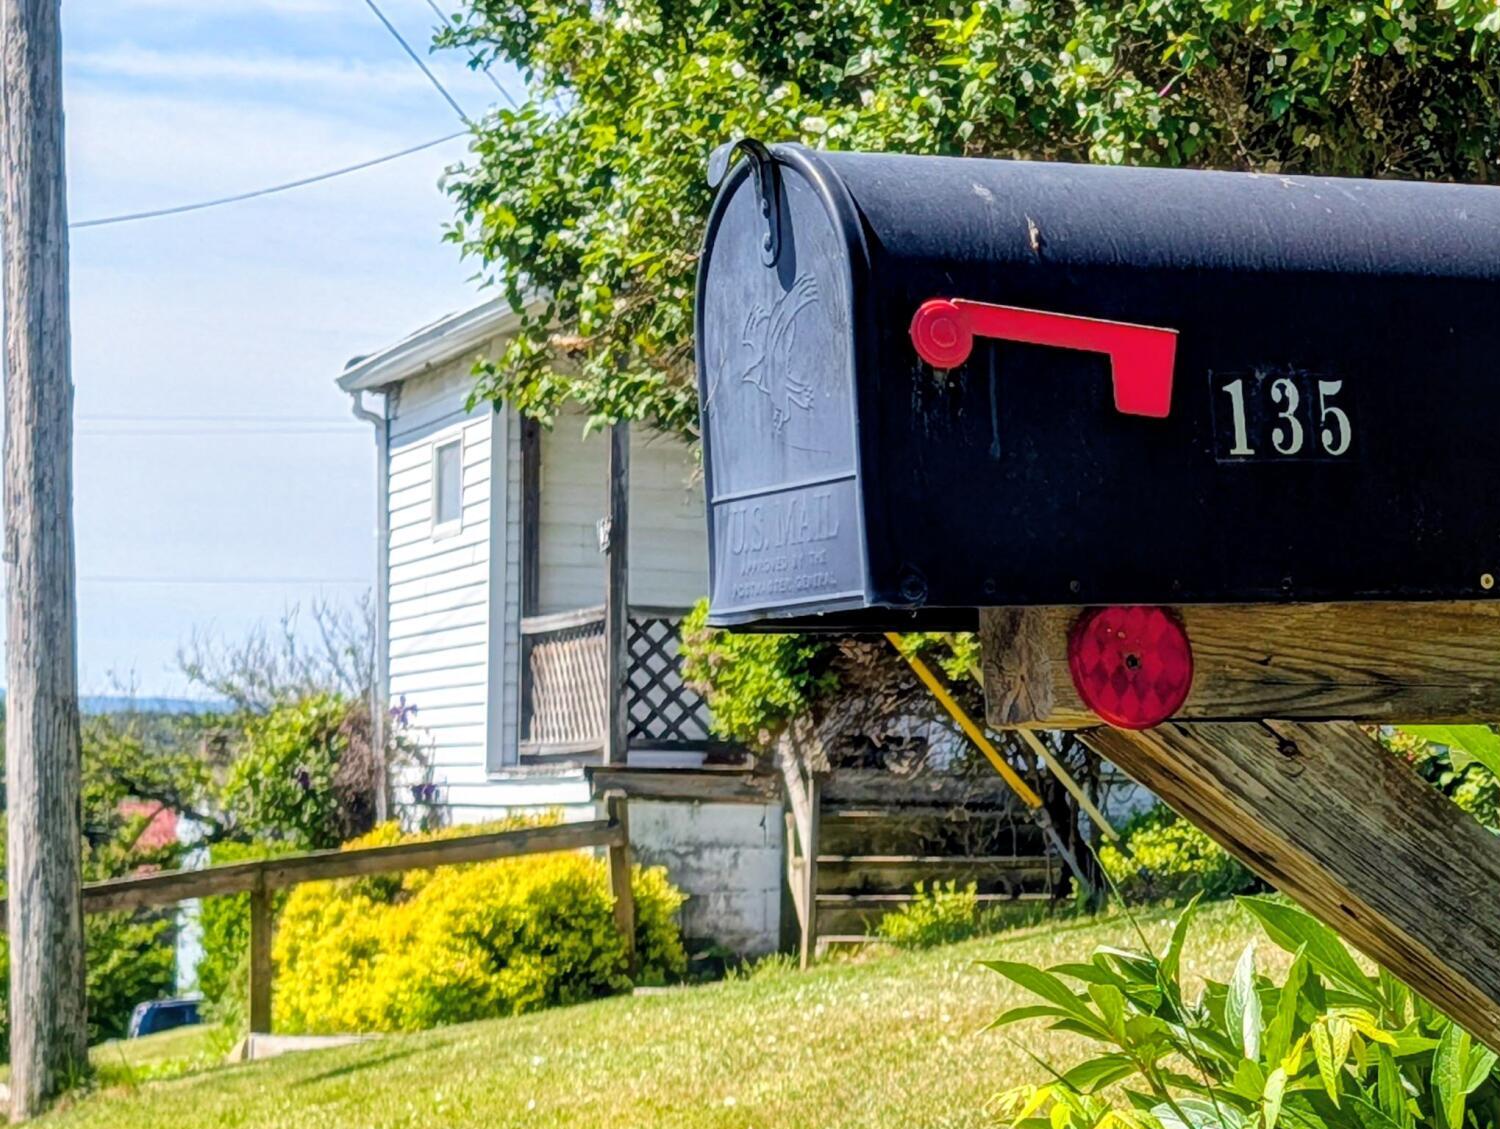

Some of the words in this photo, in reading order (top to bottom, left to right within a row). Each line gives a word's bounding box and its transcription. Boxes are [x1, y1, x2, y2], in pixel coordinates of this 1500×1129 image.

[1221, 378, 1352, 456] 135
[728, 505, 769, 556] U.S.
[774, 493, 841, 549] MAIL
